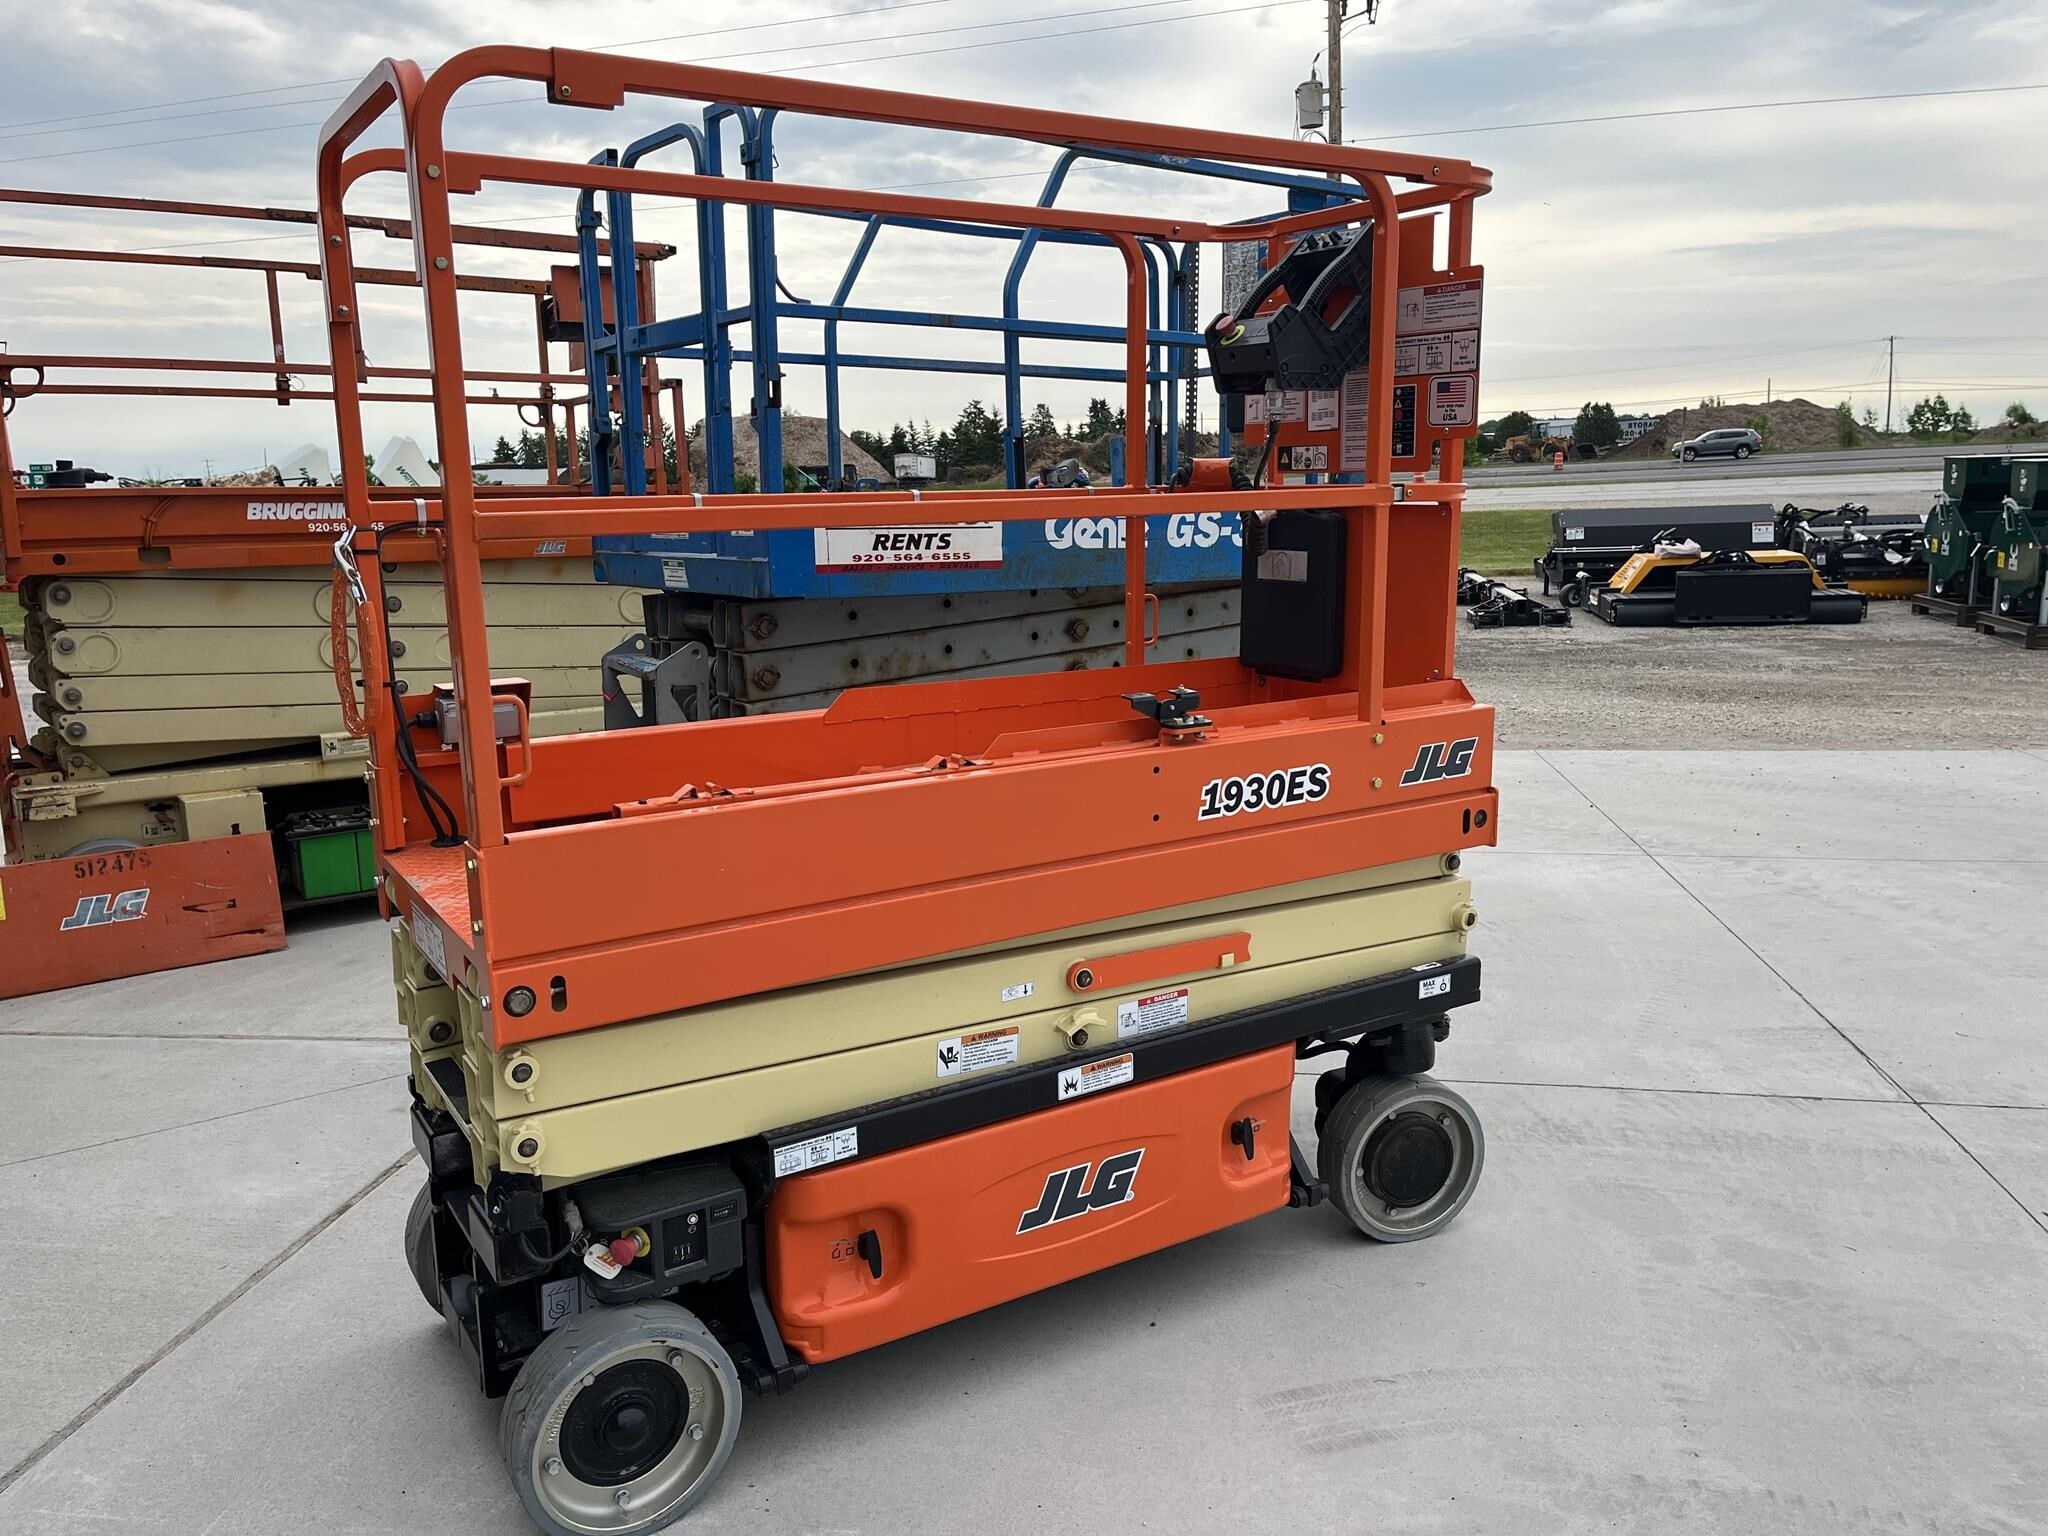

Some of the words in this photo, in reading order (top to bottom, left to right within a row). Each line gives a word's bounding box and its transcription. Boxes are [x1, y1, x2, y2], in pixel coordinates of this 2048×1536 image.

[1442, 284, 1466, 293] DANGER
[1442, 413, 1458, 421] USA
[533, 540, 567, 555] JLG
[872, 533, 952, 551] RENTS
[852, 552, 972, 563] 920-564-6555
[1400, 737, 1479, 787] JLG
[1198, 763, 1331, 821] 1930ES
[60, 888, 150, 931] JLG
[1422, 980, 1436, 988] MAX
[1153, 991, 1179, 1002] DANGER
[978, 1029, 1007, 1040] WARNING
[1097, 1057, 1124, 1069] WARNING
[1015, 1147, 1146, 1236] JLG
